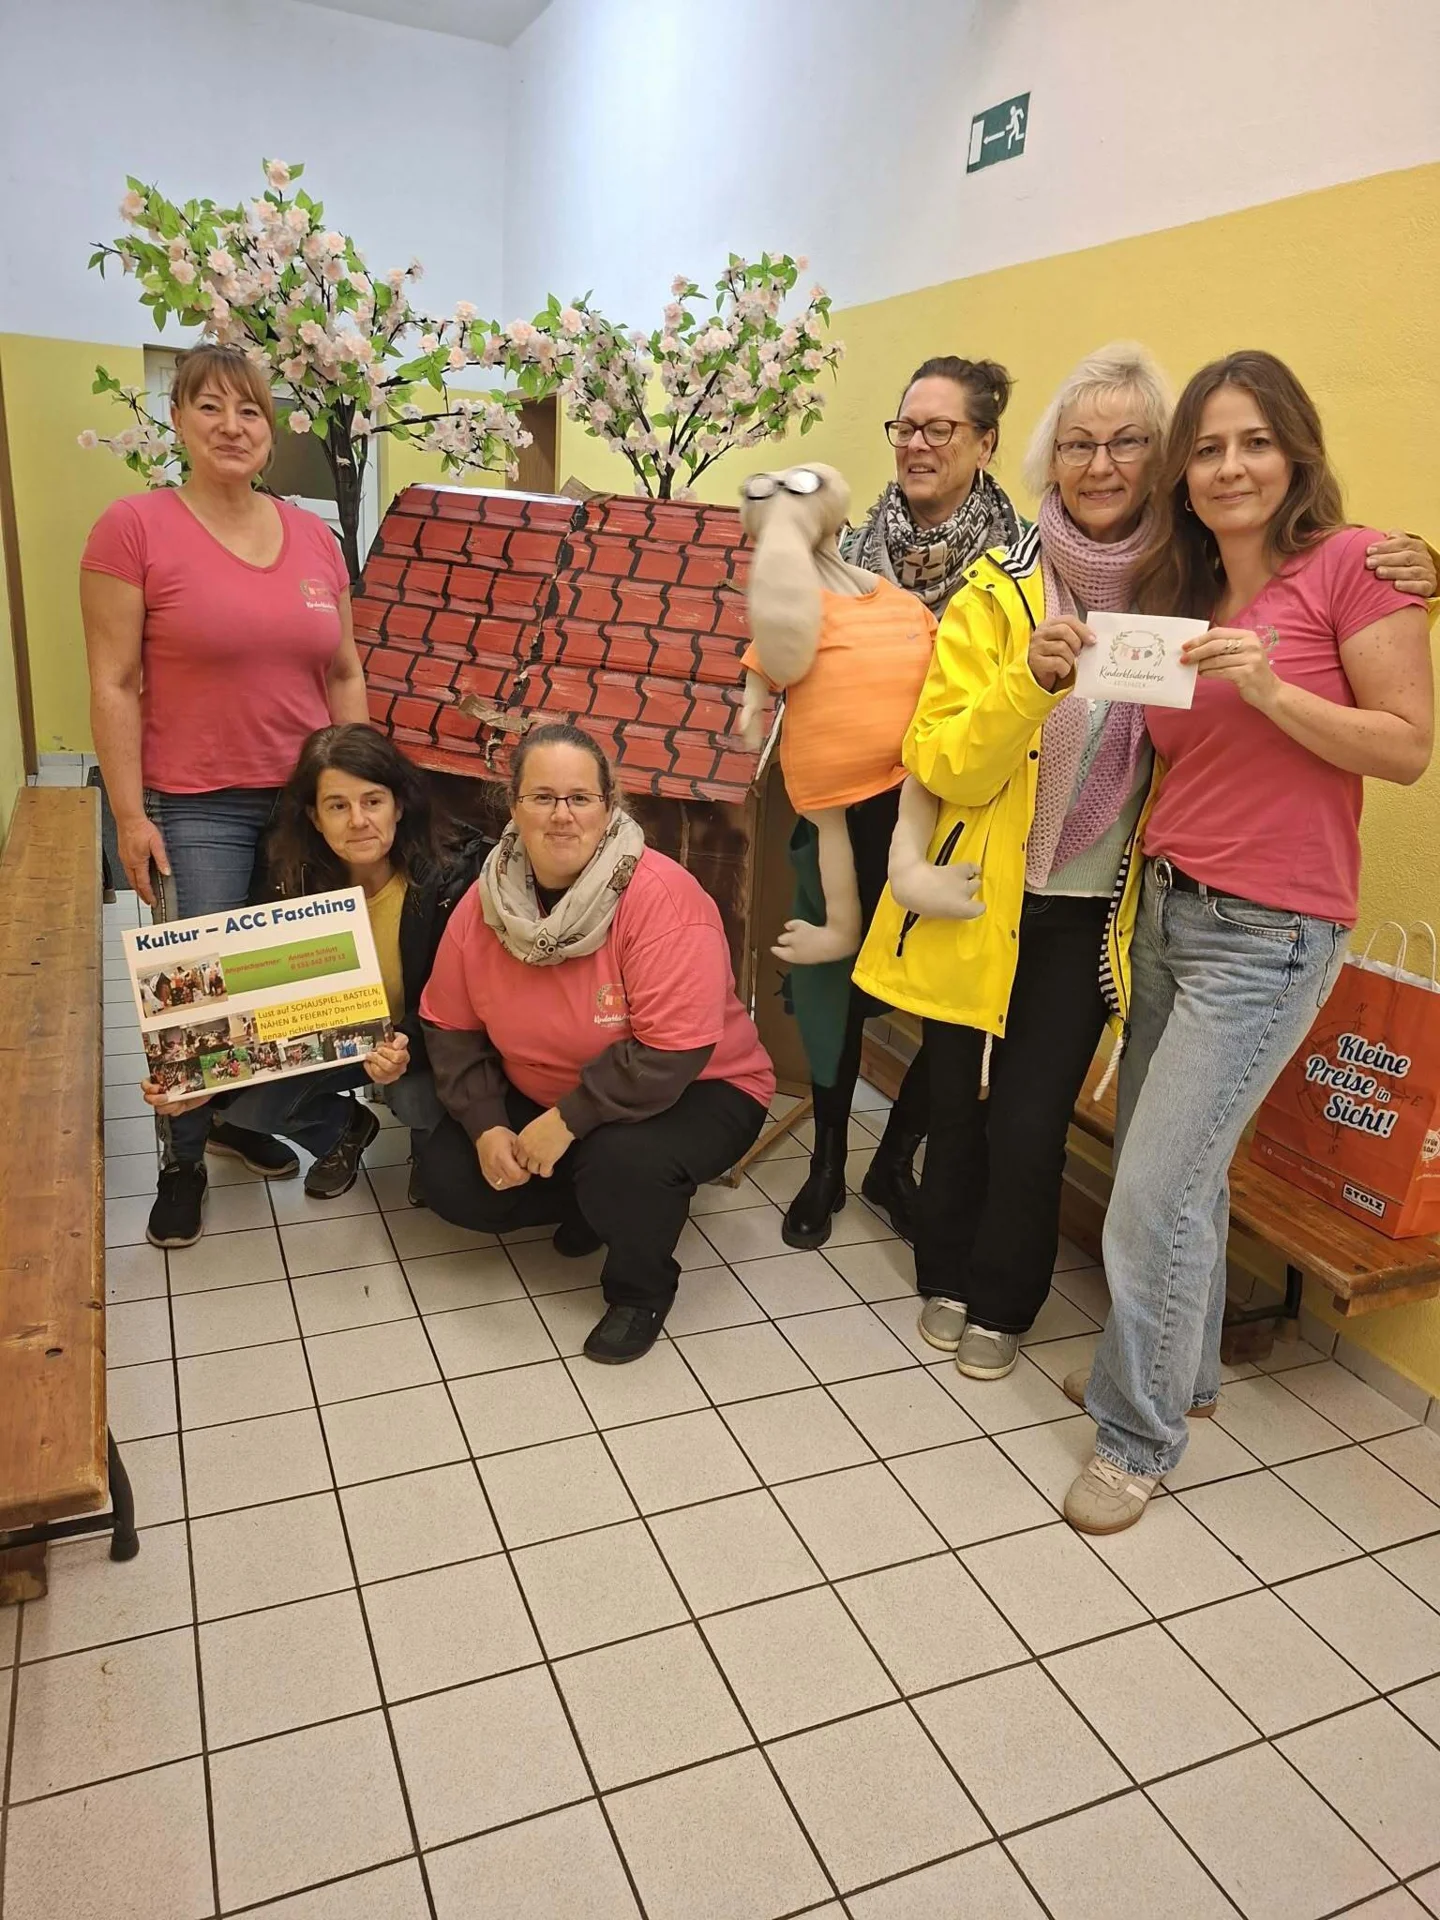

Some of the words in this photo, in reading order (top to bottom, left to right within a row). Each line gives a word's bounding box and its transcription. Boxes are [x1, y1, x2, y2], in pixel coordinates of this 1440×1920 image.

[135, 927, 200, 951] Kultur
[225, 911, 268, 934] ACC
[272, 897, 356, 925] Fasching
[258, 1010, 275, 1019] Lust
[276, 1007, 290, 1017] auf
[291, 995, 342, 1013] SCHAUSPIEL,
[343, 987, 381, 1001] BASTELN,
[260, 1016, 290, 1030] NÄHEN
[291, 1016, 298, 1024] &
[300, 1008, 333, 1022] FEIERN?
[334, 1004, 356, 1015] Dann
[357, 1000, 372, 1010] bist
[373, 998, 384, 1007] du
[262, 1031, 287, 1042] genau
[289, 1023, 315, 1037] richtig
[315, 1020, 328, 1030] bei
[329, 1018, 344, 1028] uns
[1338, 1034, 1409, 1075] Kleine
[1307, 1056, 1376, 1095] Preise
[1376, 1088, 1390, 1101] in
[1325, 1094, 1396, 1136] Sicht!
[1344, 1186, 1384, 1212] STOLZ
